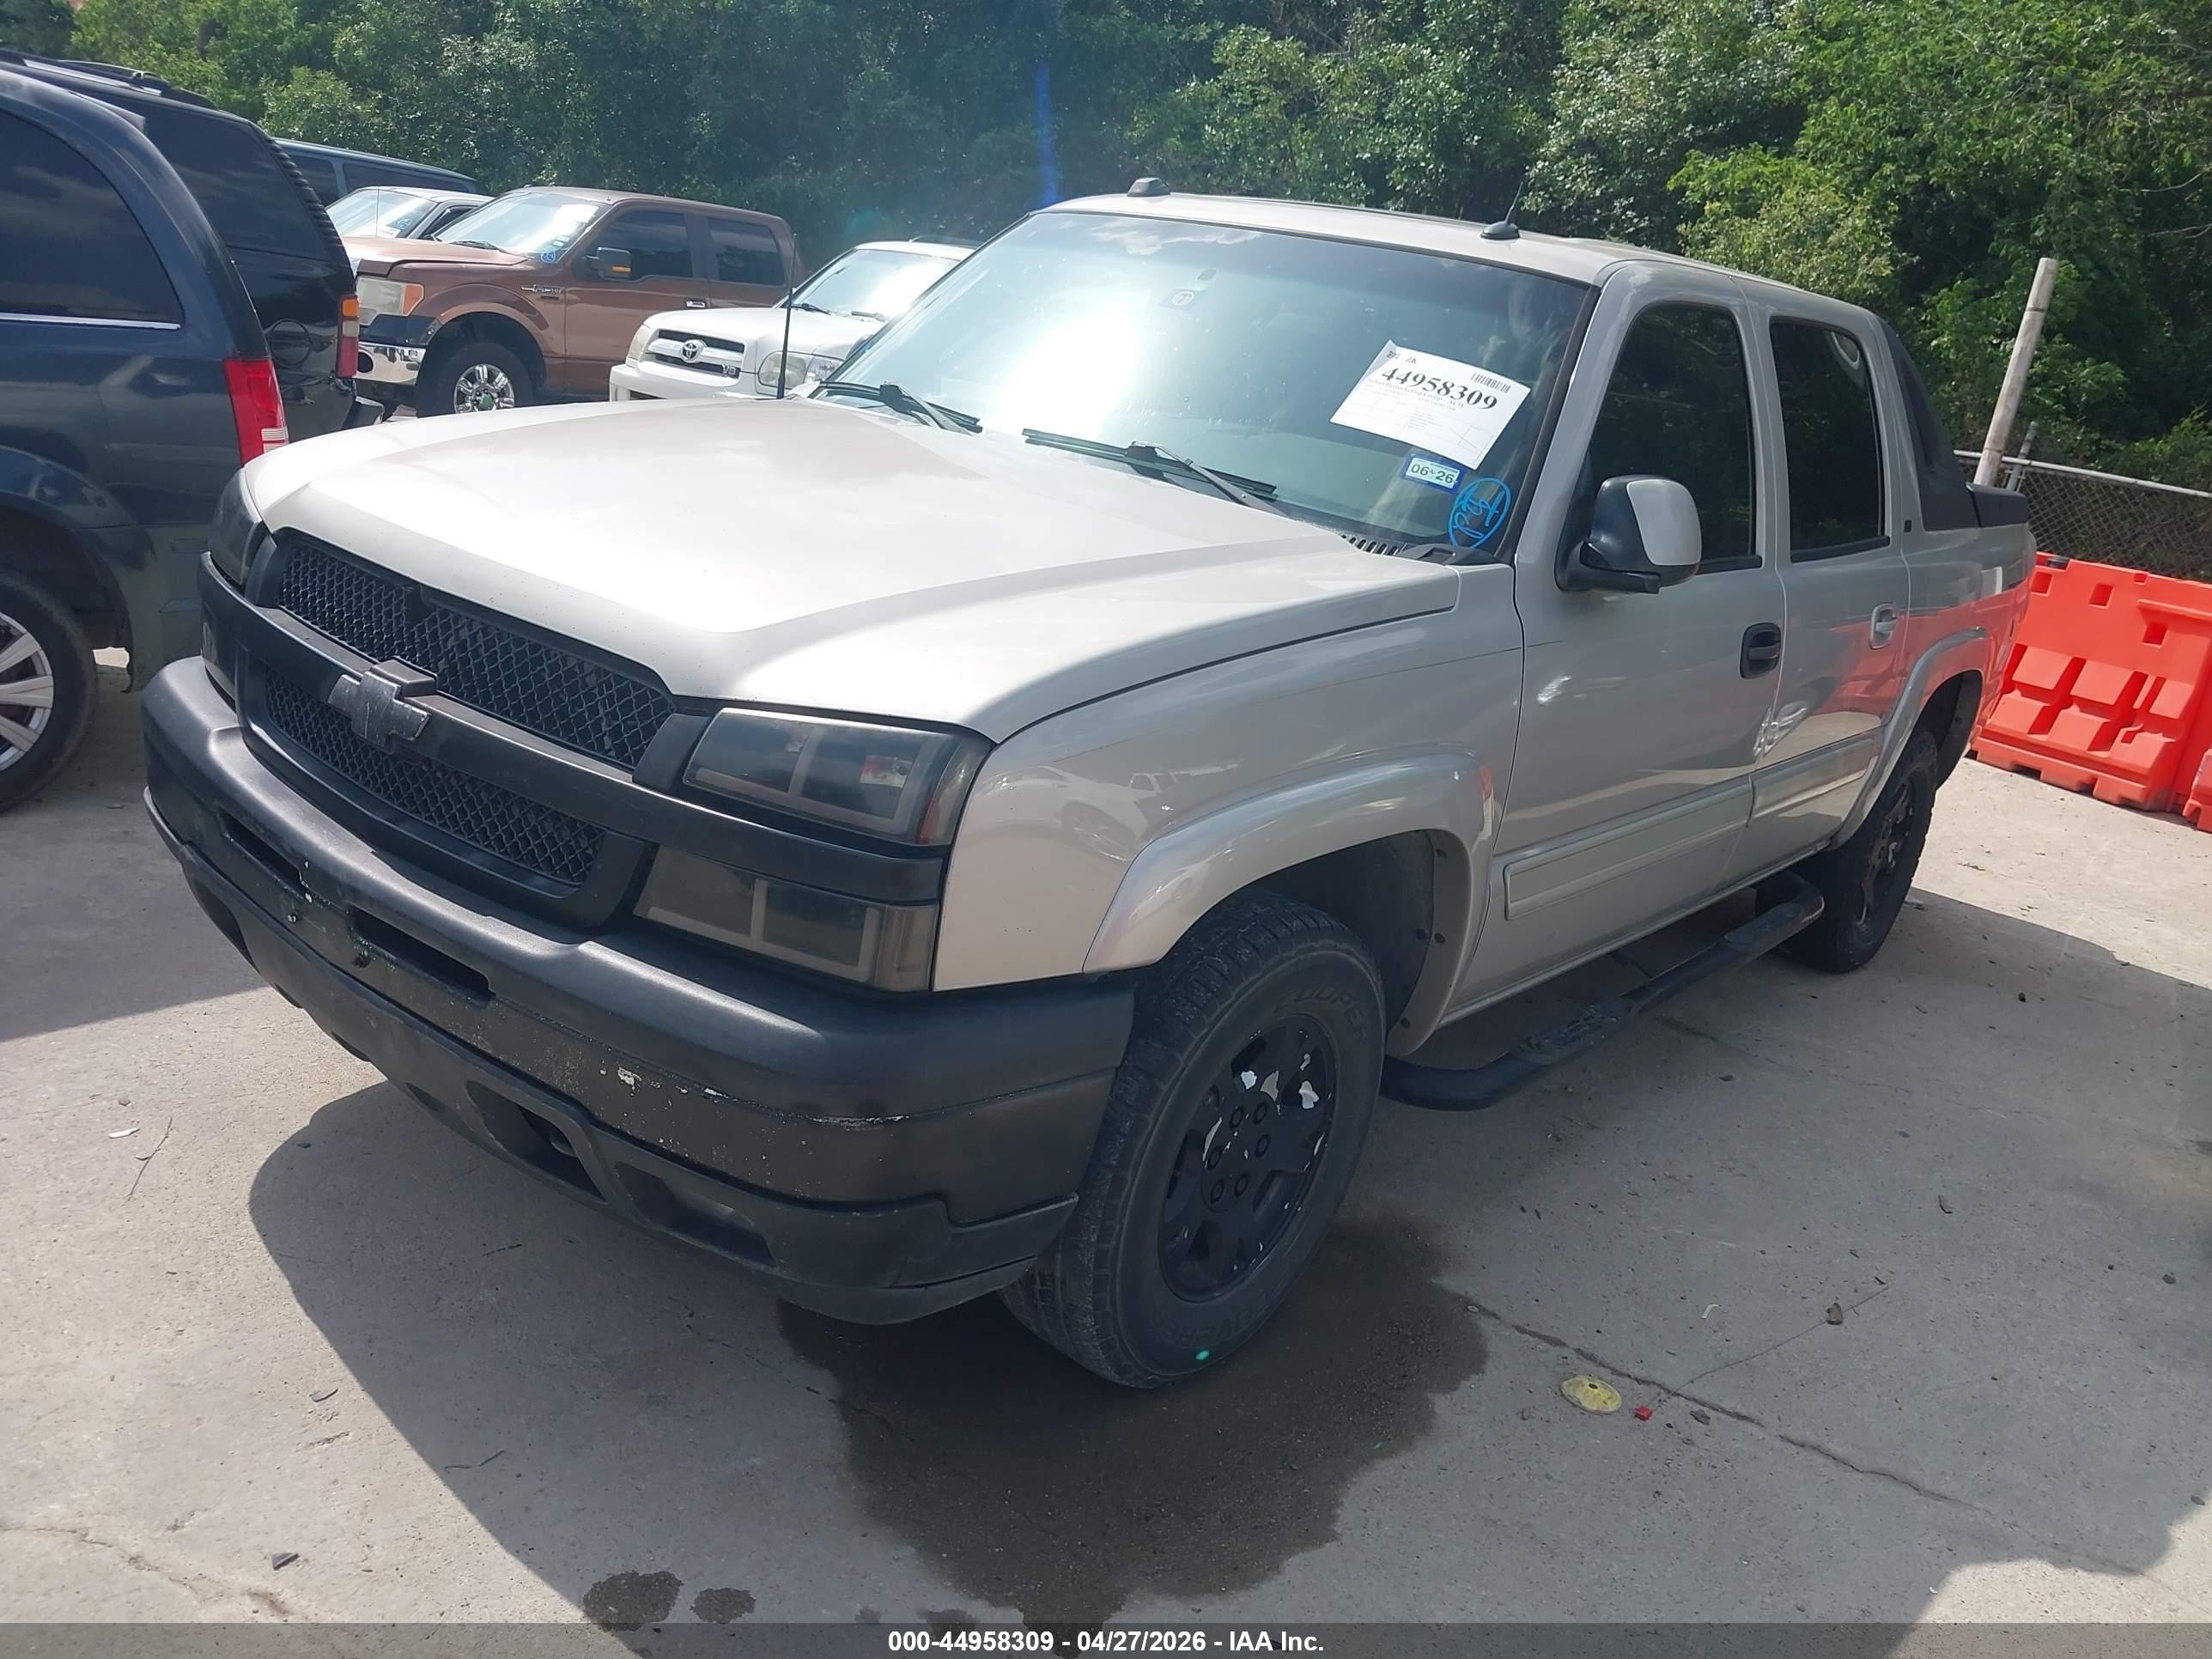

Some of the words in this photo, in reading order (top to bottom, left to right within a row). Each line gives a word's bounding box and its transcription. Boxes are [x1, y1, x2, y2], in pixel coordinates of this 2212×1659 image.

[1381, 367, 1498, 410] 44958309
[1410, 464, 1430, 476] 06
[1435, 471, 1455, 483] 26
